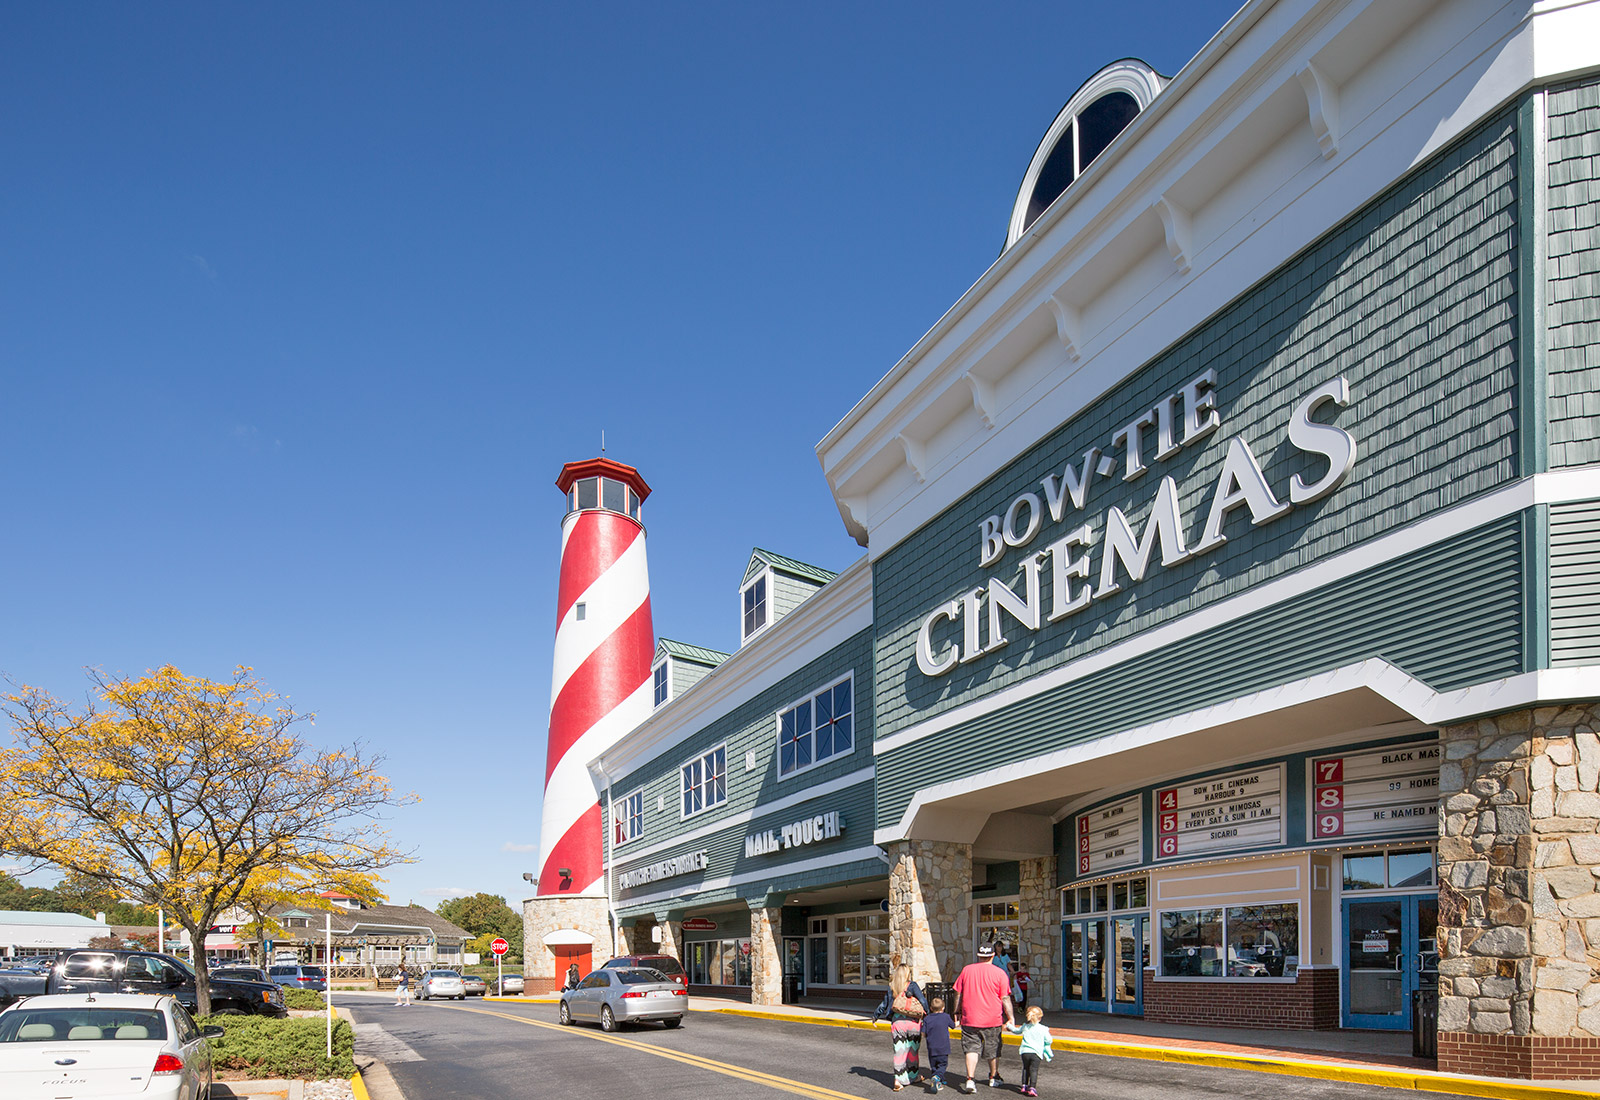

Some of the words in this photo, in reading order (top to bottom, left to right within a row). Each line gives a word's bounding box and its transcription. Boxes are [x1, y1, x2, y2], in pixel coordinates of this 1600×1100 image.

[978, 446, 1102, 569] BOW
[1111, 367, 1221, 482] TIE
[915, 375, 1357, 677] CINEMAS
[1382, 752, 1413, 764] BLACK
[1320, 762, 1339, 780] 7
[1193, 786, 1208, 795] BOW
[1212, 783, 1223, 792] TIE
[1228, 776, 1259, 788] CINEMAS
[1389, 782, 1401, 791] 99
[1162, 793, 1176, 808] 4
[1205, 790, 1236, 801] HARBOUR
[1320, 789, 1339, 807] 8
[1191, 808, 1215, 819] MOVIES
[1229, 801, 1261, 813] MIMOSAS
[1374, 811, 1385, 820] HE
[1391, 807, 1425, 818] NAMED
[1163, 815, 1175, 831] 5
[1185, 819, 1205, 828] EVERY
[1209, 816, 1221, 825] SAT
[1232, 812, 1246, 821] SUN
[1260, 808, 1272, 816] AM
[1320, 815, 1339, 834] 9
[1081, 819, 1087, 833] 1
[744, 829, 780, 858] NAIL
[781, 811, 840, 849] TOUCH
[1210, 829, 1238, 840] SICARIO
[1081, 838, 1088, 852] 2
[1162, 838, 1175, 853] 6
[1081, 857, 1088, 871] 3
